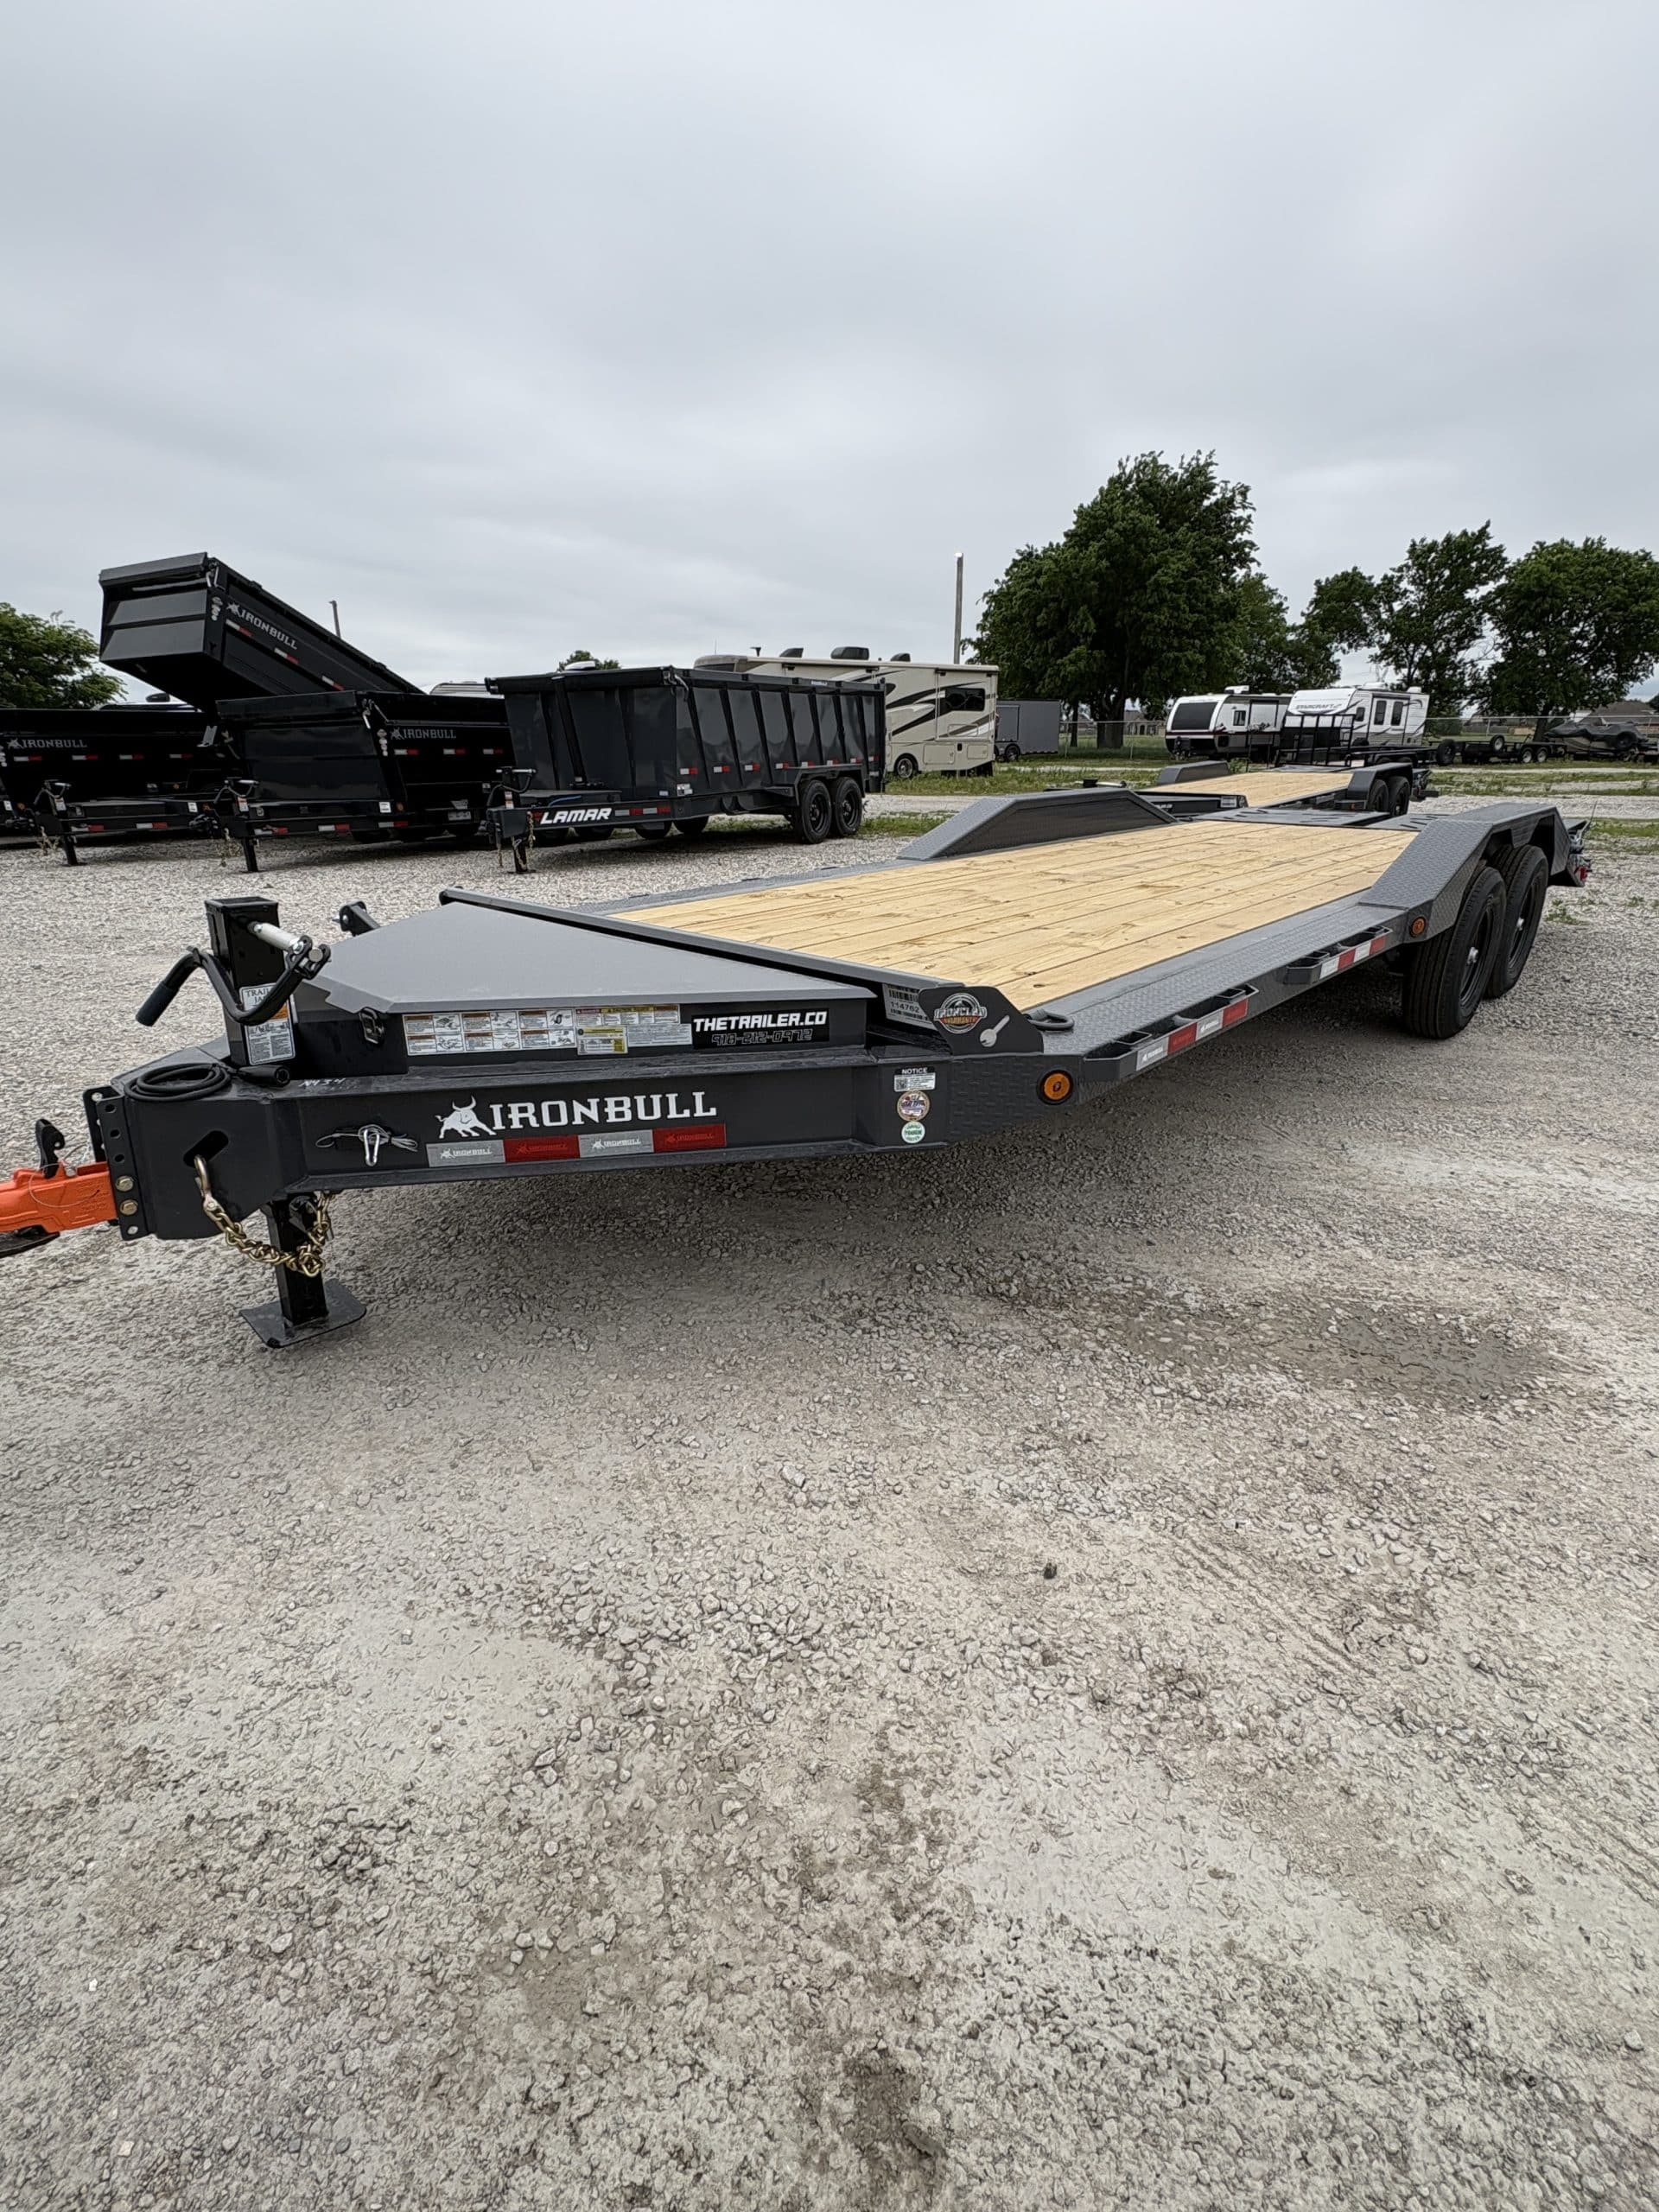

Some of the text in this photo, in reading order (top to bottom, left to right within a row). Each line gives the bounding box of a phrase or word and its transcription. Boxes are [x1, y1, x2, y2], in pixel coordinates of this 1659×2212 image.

[241, 609, 298, 650] IRONBULL
[403, 728, 457, 739] IRONBULL
[22, 739, 88, 748] IRONBULL
[540, 808, 612, 824] LAMAR
[693, 1011, 828, 1033] THETRAILER.CO
[711, 1028, 813, 1046] 918-212-0972
[901, 1066, 928, 1075] NOTICE
[489, 1091, 717, 1130] IRONBULL
[604, 1138, 641, 1147] IRONBULL
[452, 1147, 493, 1156] IRONBULL
